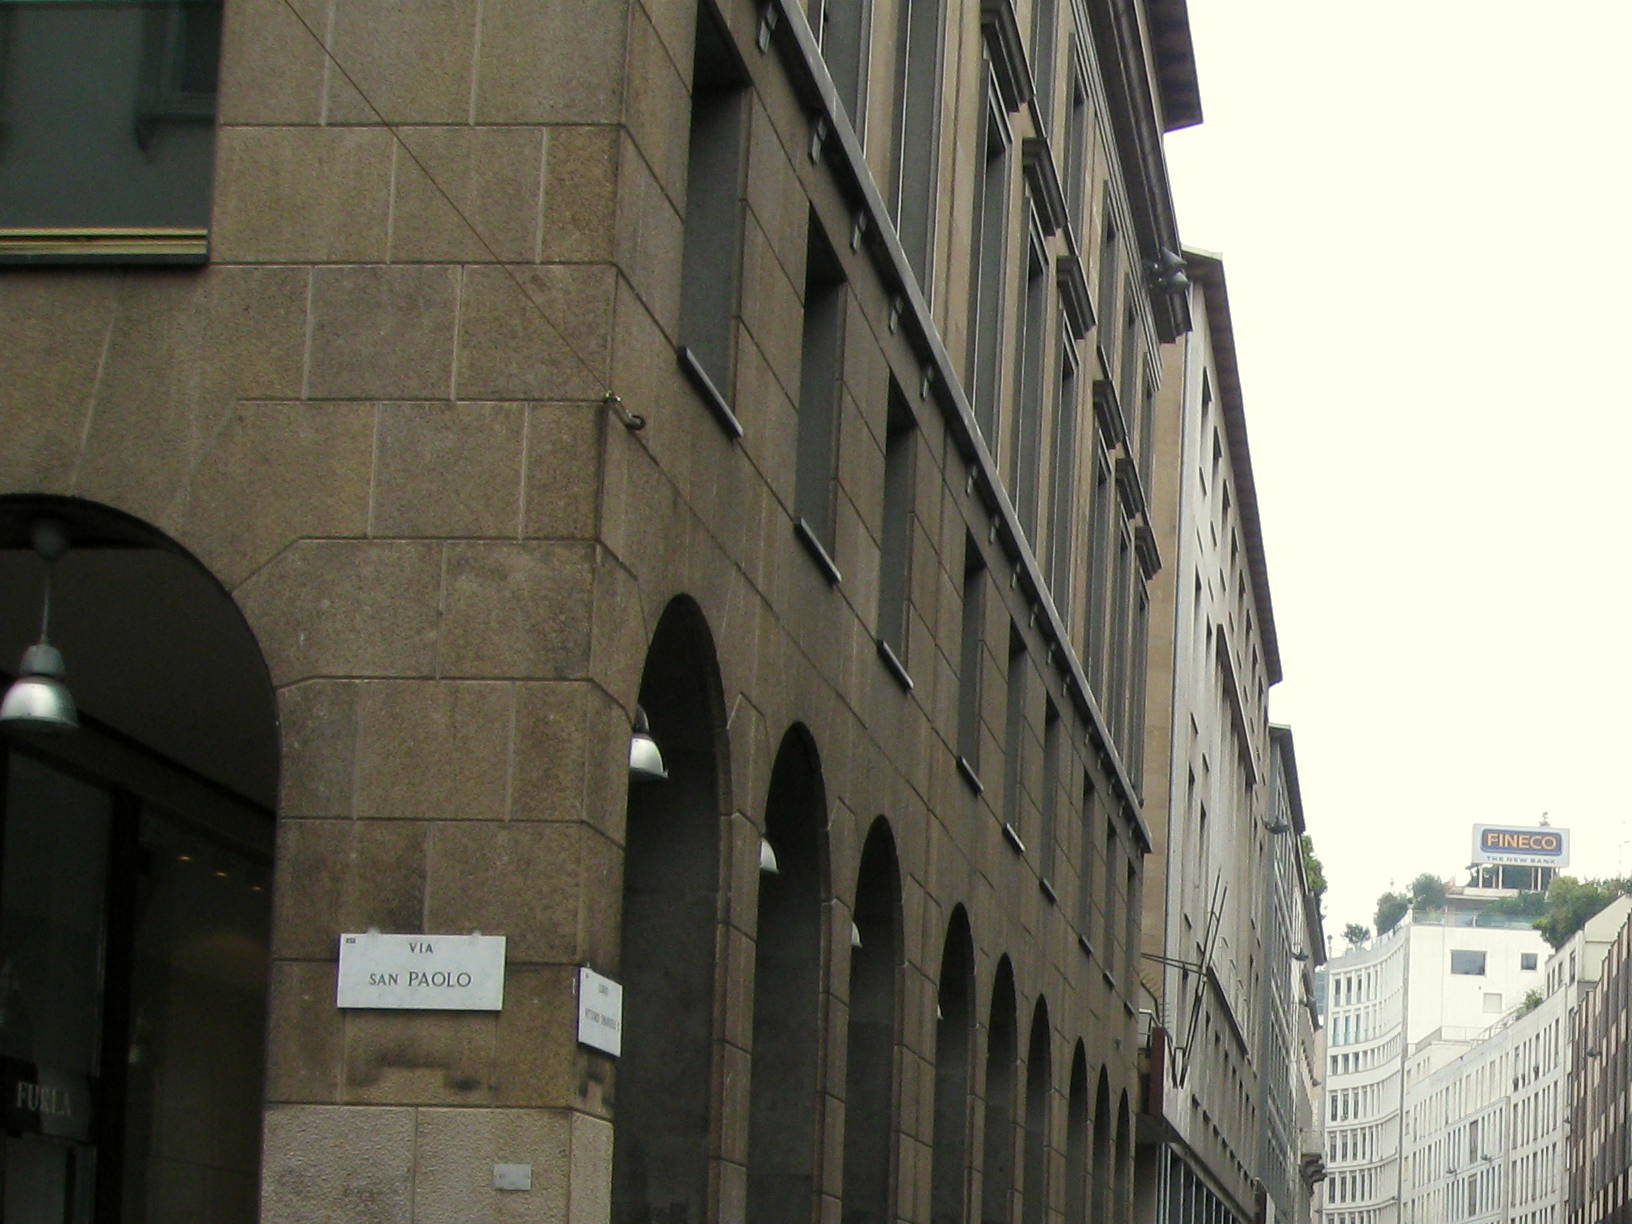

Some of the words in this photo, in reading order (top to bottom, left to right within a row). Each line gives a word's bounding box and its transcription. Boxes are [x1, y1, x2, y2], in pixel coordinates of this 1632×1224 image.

[1486, 832, 1557, 850] FINECO
[408, 942, 434, 955] VIA
[368, 973, 399, 987] SAN
[407, 970, 472, 988] PAOLO
[16, 1080, 72, 1117] FURLA
